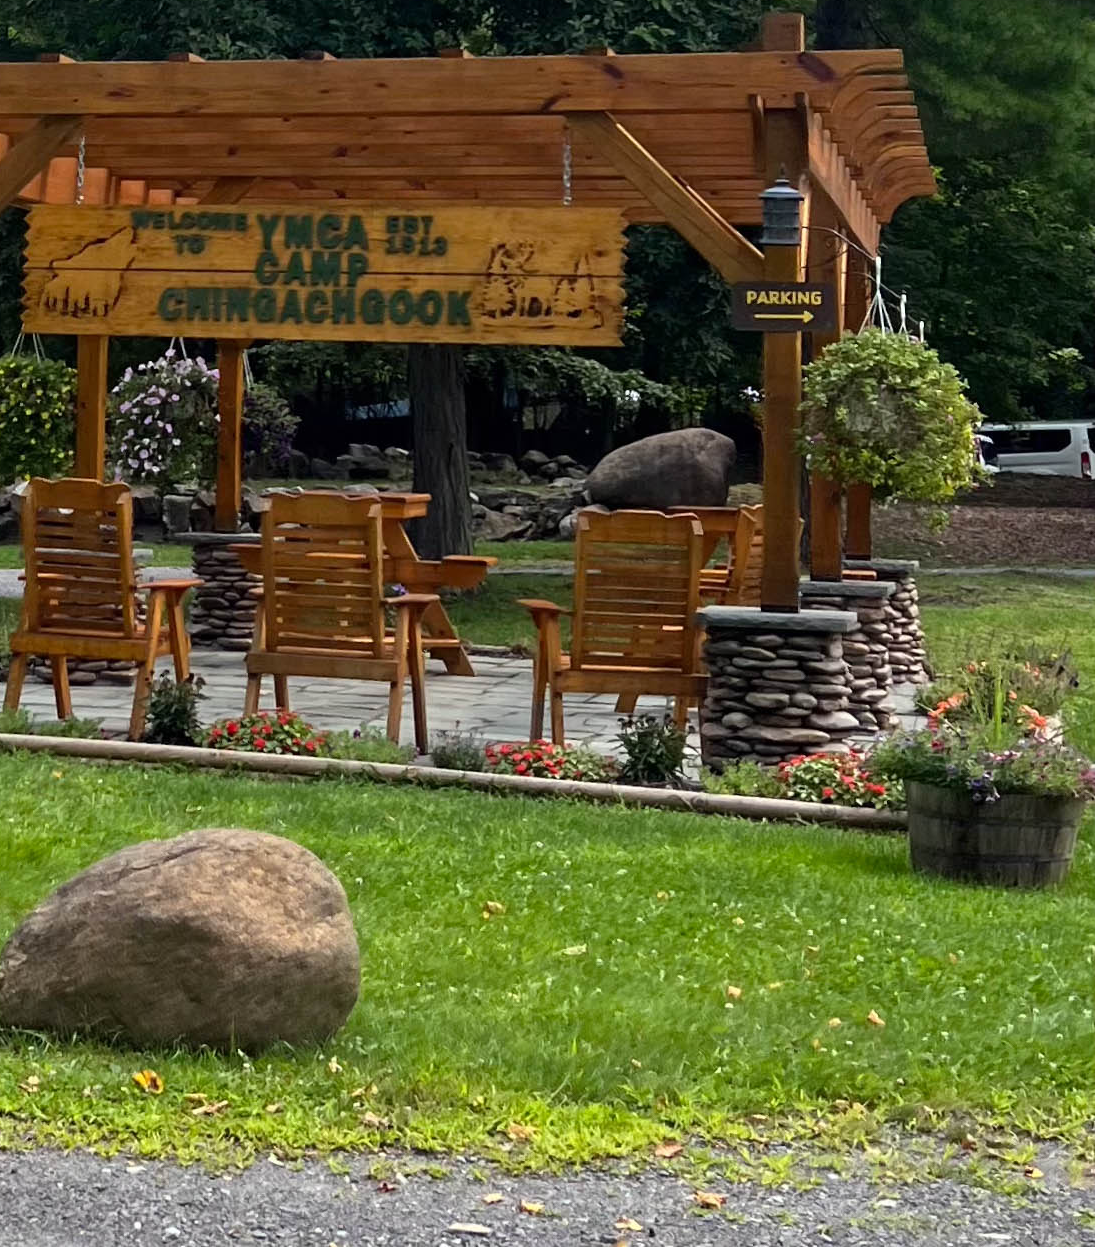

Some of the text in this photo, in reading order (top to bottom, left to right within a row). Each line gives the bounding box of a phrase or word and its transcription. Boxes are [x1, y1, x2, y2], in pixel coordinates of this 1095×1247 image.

[131, 211, 247, 231] WELCOME
[256, 214, 369, 250] YMCA
[173, 234, 206, 255] TO
[256, 251, 368, 287] CAMP
[158, 288, 472, 326] CHINGACHGOOK
[746, 290, 822, 305] PARKING
